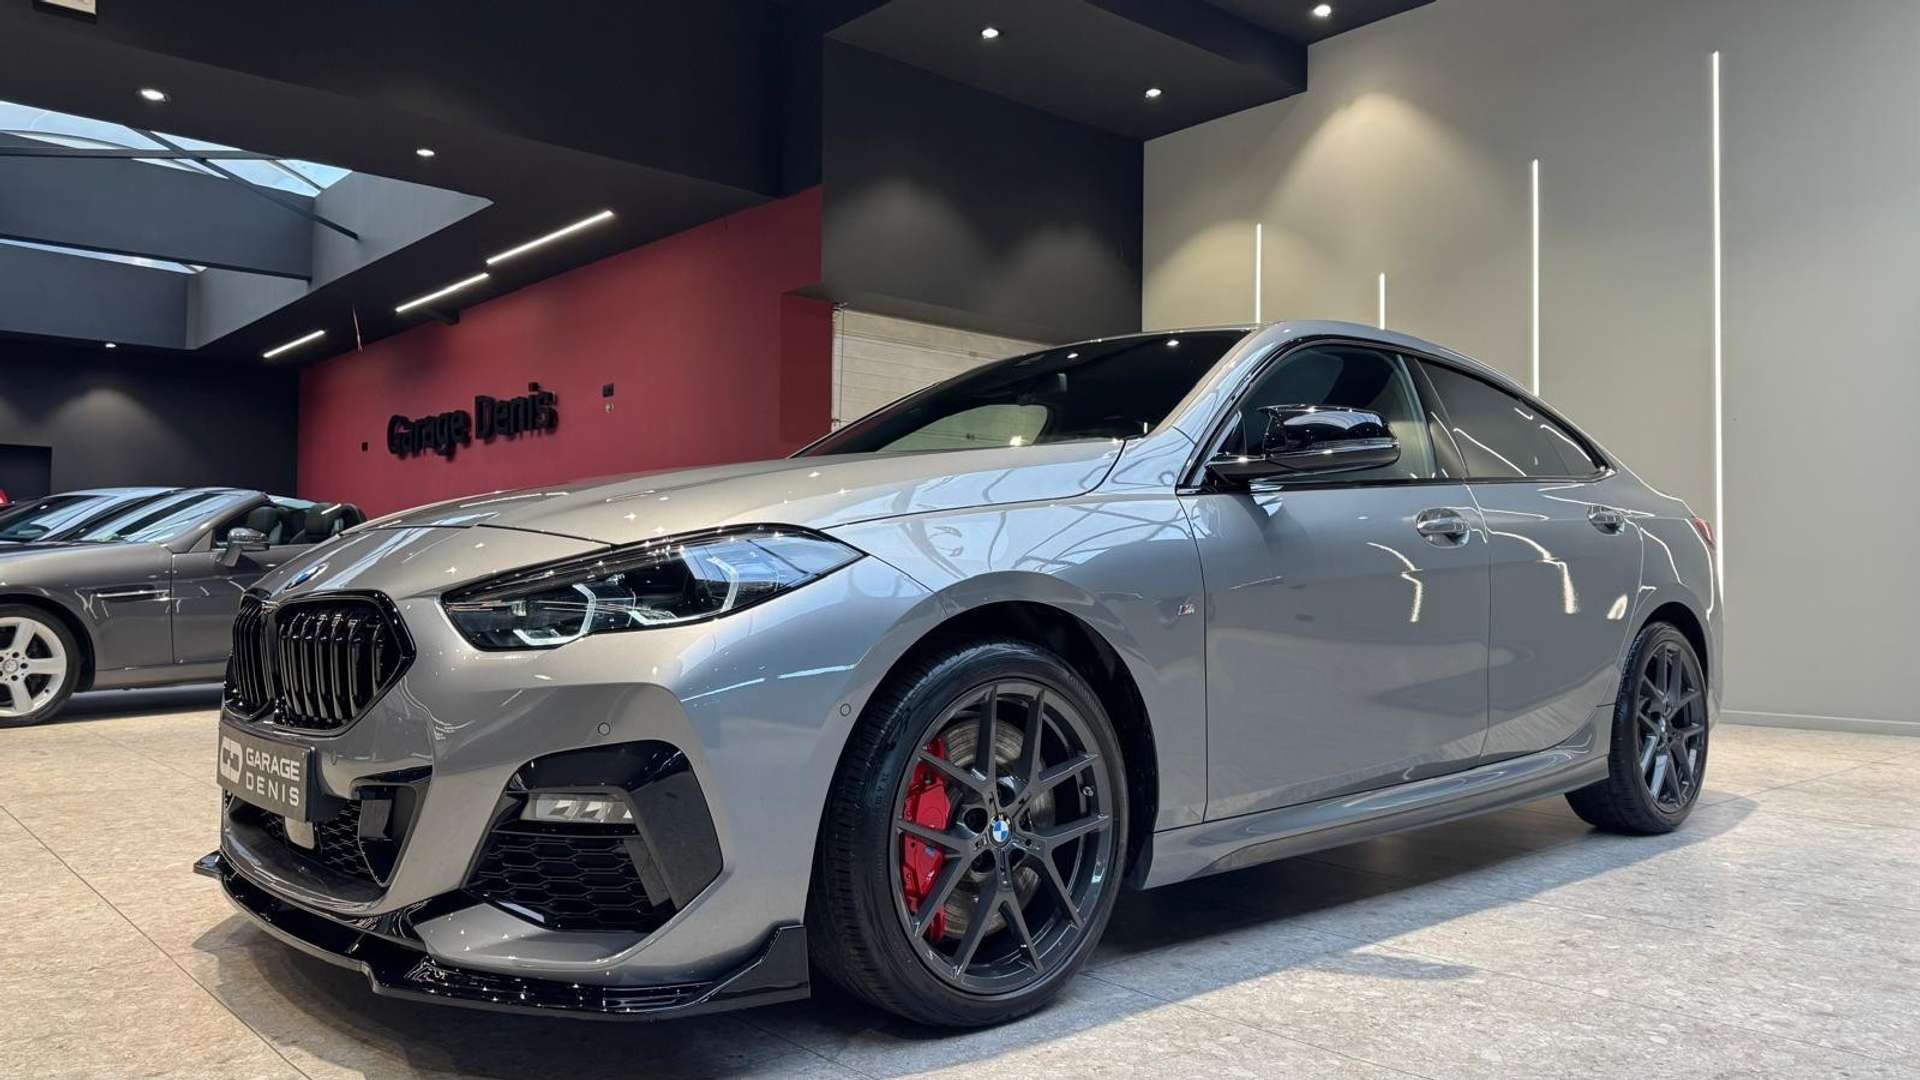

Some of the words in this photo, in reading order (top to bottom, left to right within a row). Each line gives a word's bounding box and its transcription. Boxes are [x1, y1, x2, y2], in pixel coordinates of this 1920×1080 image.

[387, 411, 471, 460] Garage
[475, 383, 558, 441] Denis
[246, 747, 300, 782] GARAGE
[246, 771, 299, 807] DENIS
